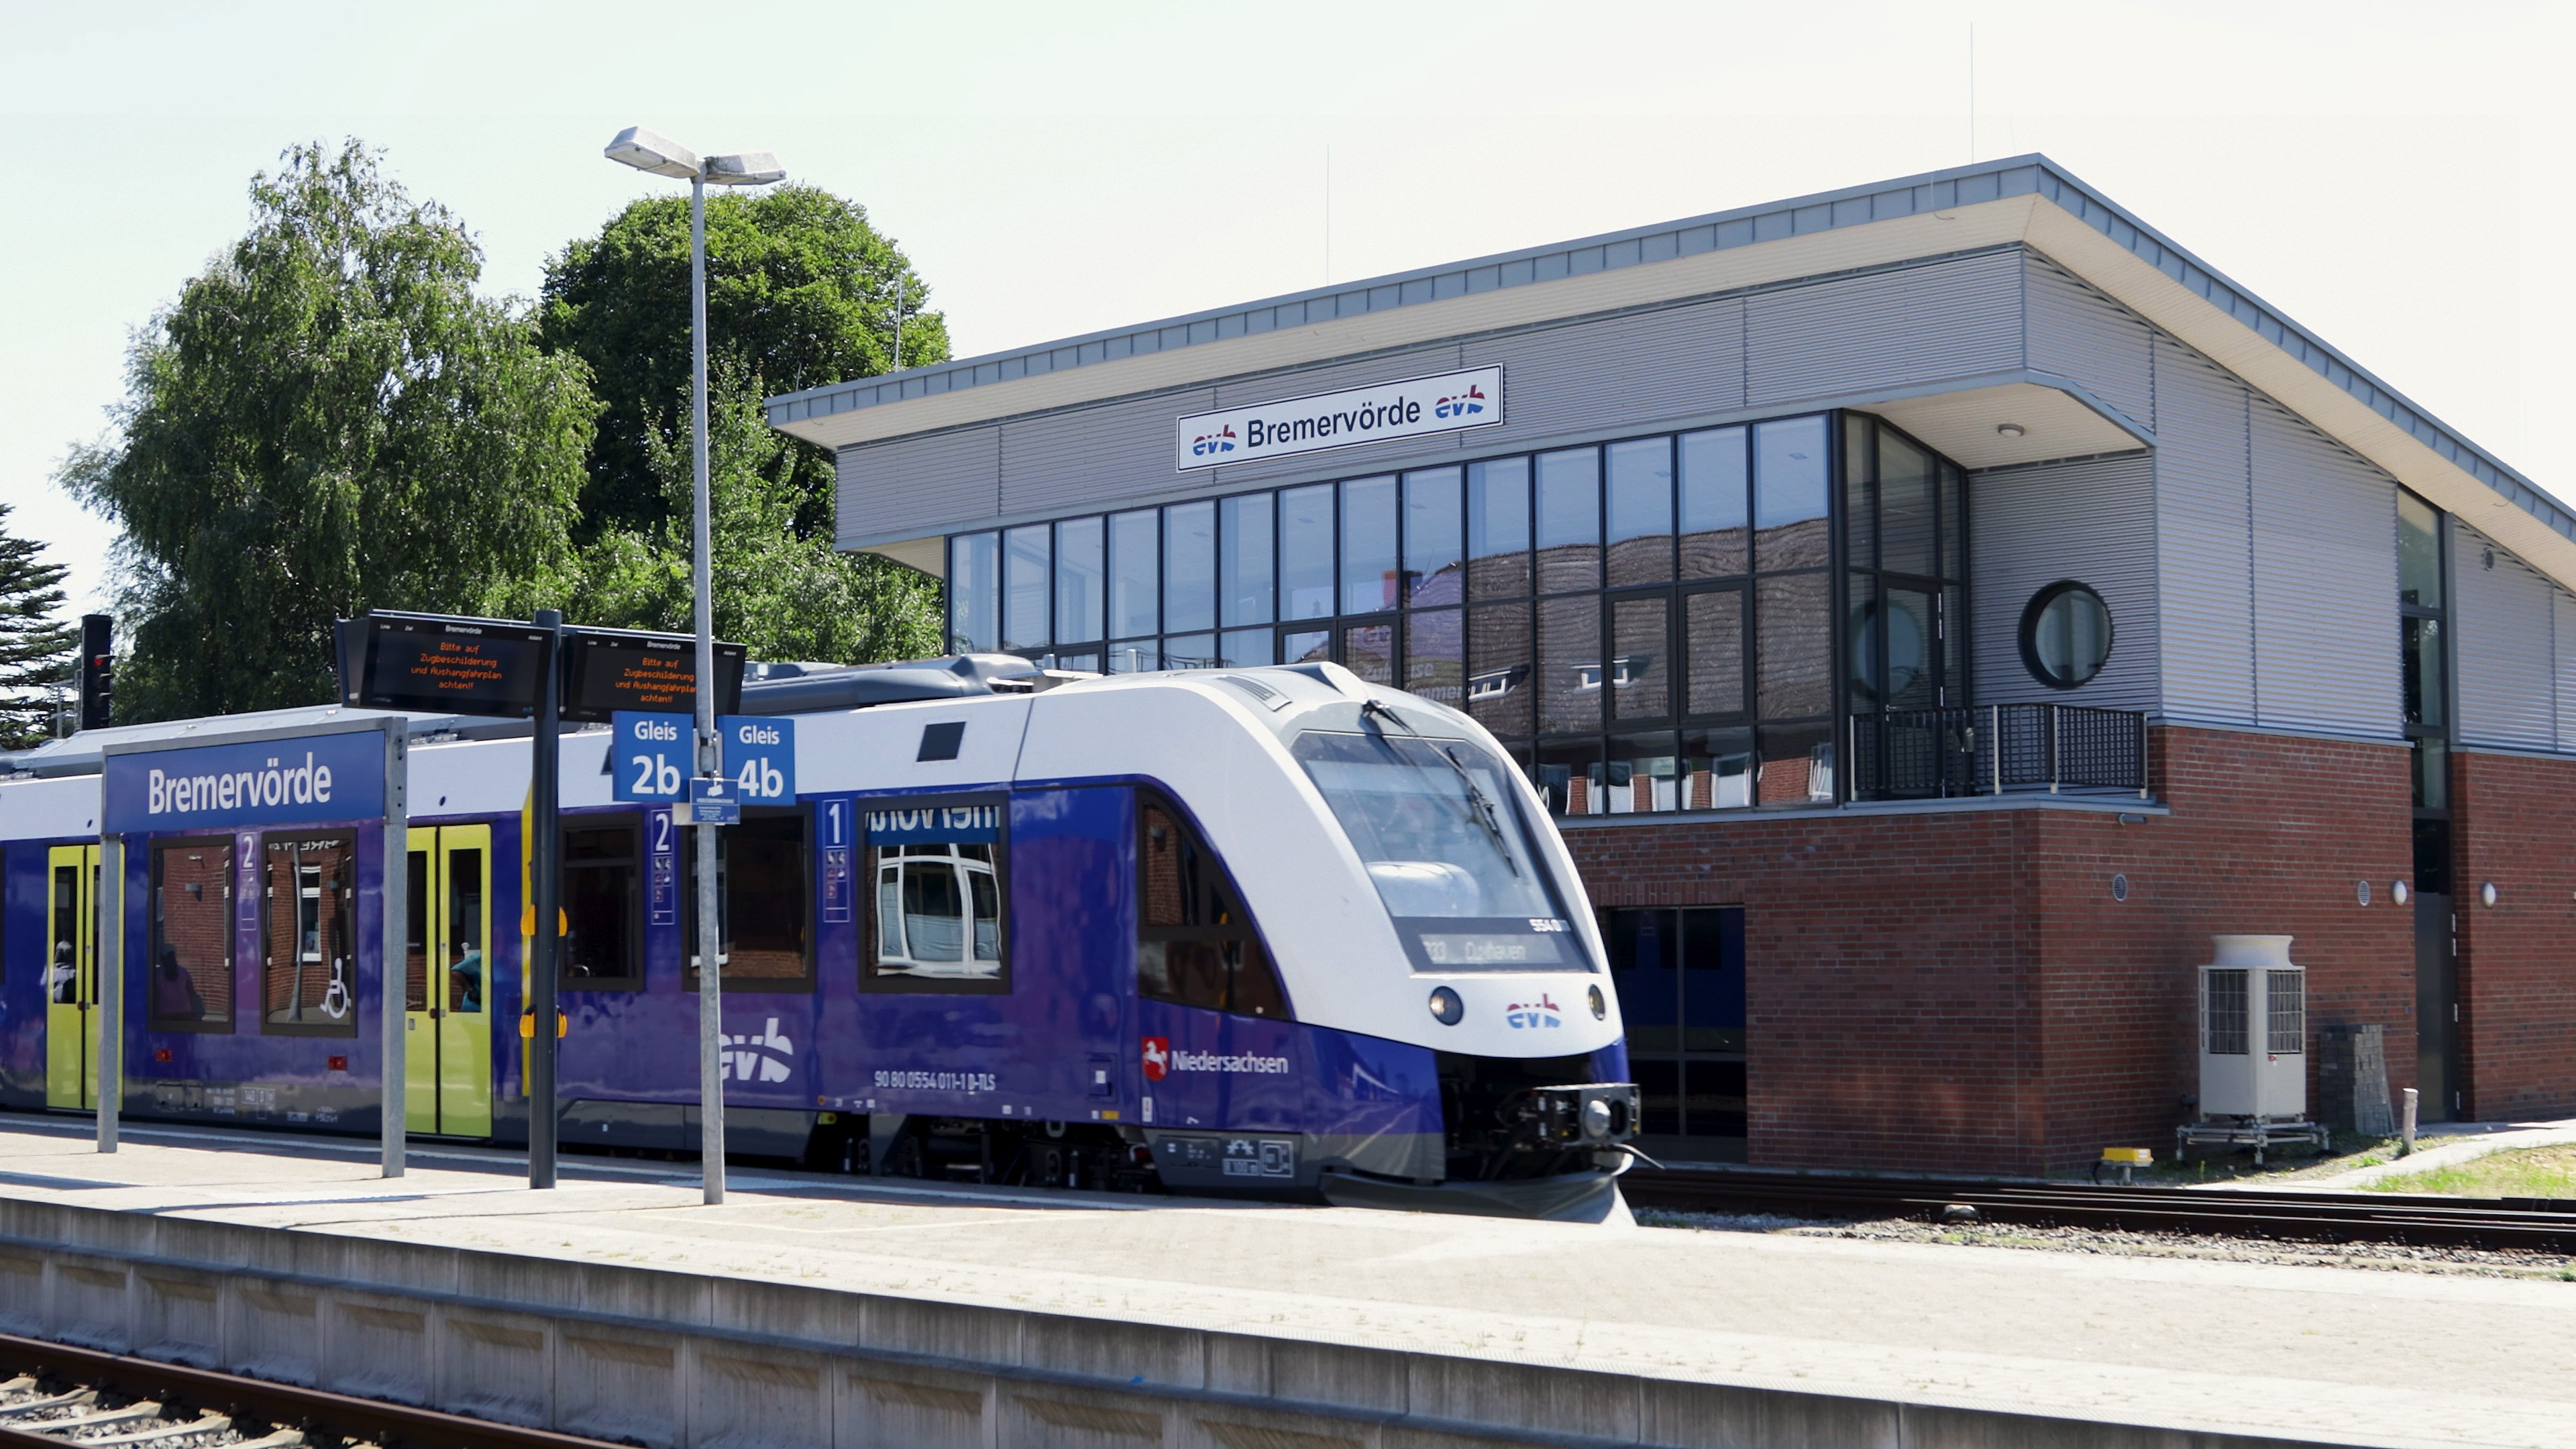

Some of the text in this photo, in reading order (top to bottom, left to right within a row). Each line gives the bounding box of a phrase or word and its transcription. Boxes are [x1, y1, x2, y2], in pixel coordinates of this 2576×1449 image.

[1193, 384, 1485, 456] evb Bremervörde evb
[445, 625, 482, 635] Bremervörde
[440, 642, 480, 655] Bitte auf
[647, 641, 681, 651] Bremervörde
[420, 653, 498, 668] Zugbeschilderung
[642, 657, 680, 669] Bitte auf
[411, 666, 502, 680] und Aushangfahrplan
[624, 668, 695, 682] Zugbeschilderung
[438, 681, 474, 690] achten!!
[633, 680, 697, 694] Aushangfahrpla
[640, 694, 674, 703] achten!!
[635, 720, 678, 741] Gleis
[739, 725, 780, 745] Gleis
[149, 751, 331, 814] Bremervörde
[632, 753, 681, 795] 2b
[739, 757, 784, 798] 4b
[655, 812, 669, 851] 2
[828, 803, 840, 844] 1
[243, 835, 254, 868] 2
[1507, 993, 1561, 1028] evb
[1171, 1050, 1289, 1073] Niedersachsen
[874, 1071, 890, 1087] 90
[890, 1071, 906, 1087] 80
[907, 1071, 936, 1088] 0554
[938, 1073, 966, 1089] 011-1
